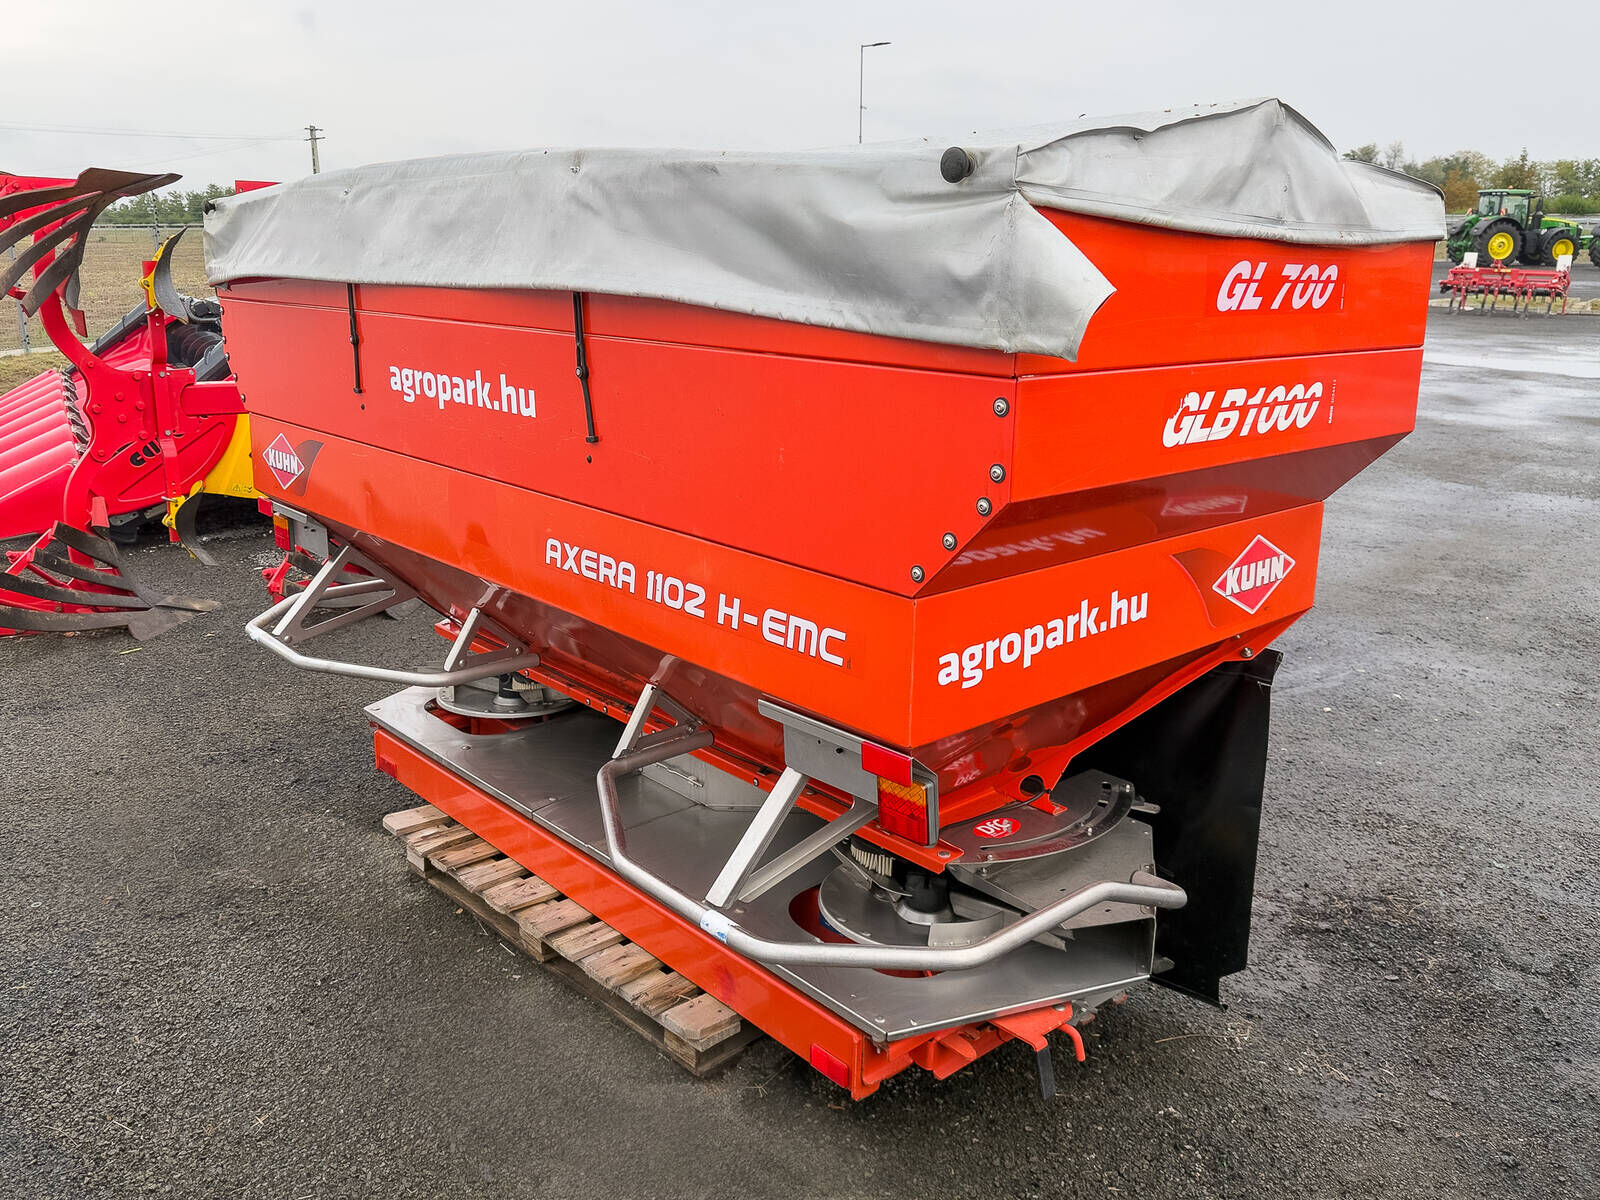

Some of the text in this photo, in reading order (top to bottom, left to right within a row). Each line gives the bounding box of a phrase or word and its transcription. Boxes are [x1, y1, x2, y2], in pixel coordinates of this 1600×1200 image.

[1217, 261, 1267, 311] GL
[1271, 264, 1337, 309] 700
[390, 366, 536, 417] agropark.hu
[268, 448, 300, 475] KUHN
[1225, 554, 1286, 596] KUHN
[546, 539, 845, 665] AXERA 1102 H-EMC
[938, 591, 1147, 688] agropark.hu
